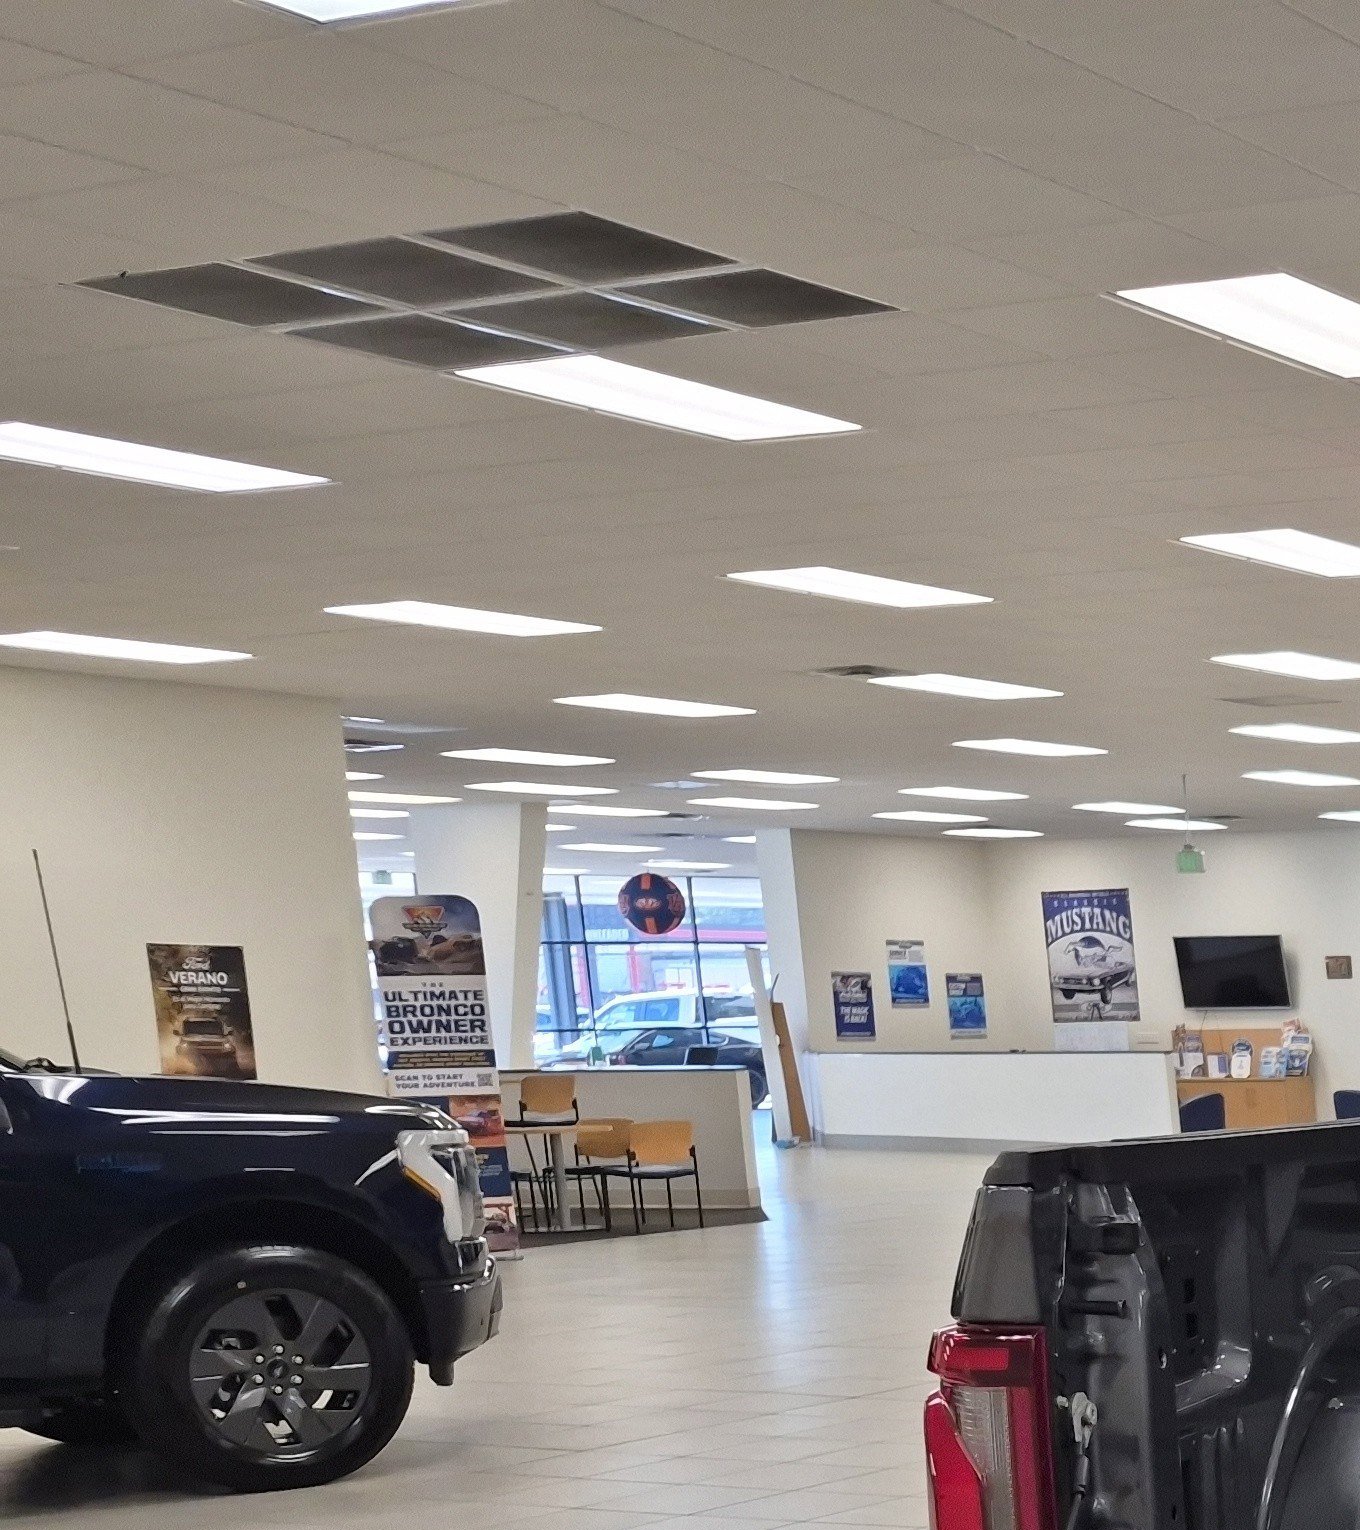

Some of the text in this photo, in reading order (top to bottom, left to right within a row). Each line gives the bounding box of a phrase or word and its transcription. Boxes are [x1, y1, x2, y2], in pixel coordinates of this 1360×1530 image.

[1046, 907, 1131, 944] MUSTANG
[182, 956, 211, 970] Ford
[168, 971, 229, 985] VERANO
[383, 989, 485, 1002] ULTIMATE
[385, 1003, 486, 1018] BRONCO
[388, 1018, 488, 1034] OWNER
[389, 1035, 490, 1046] EXPERIENCE
